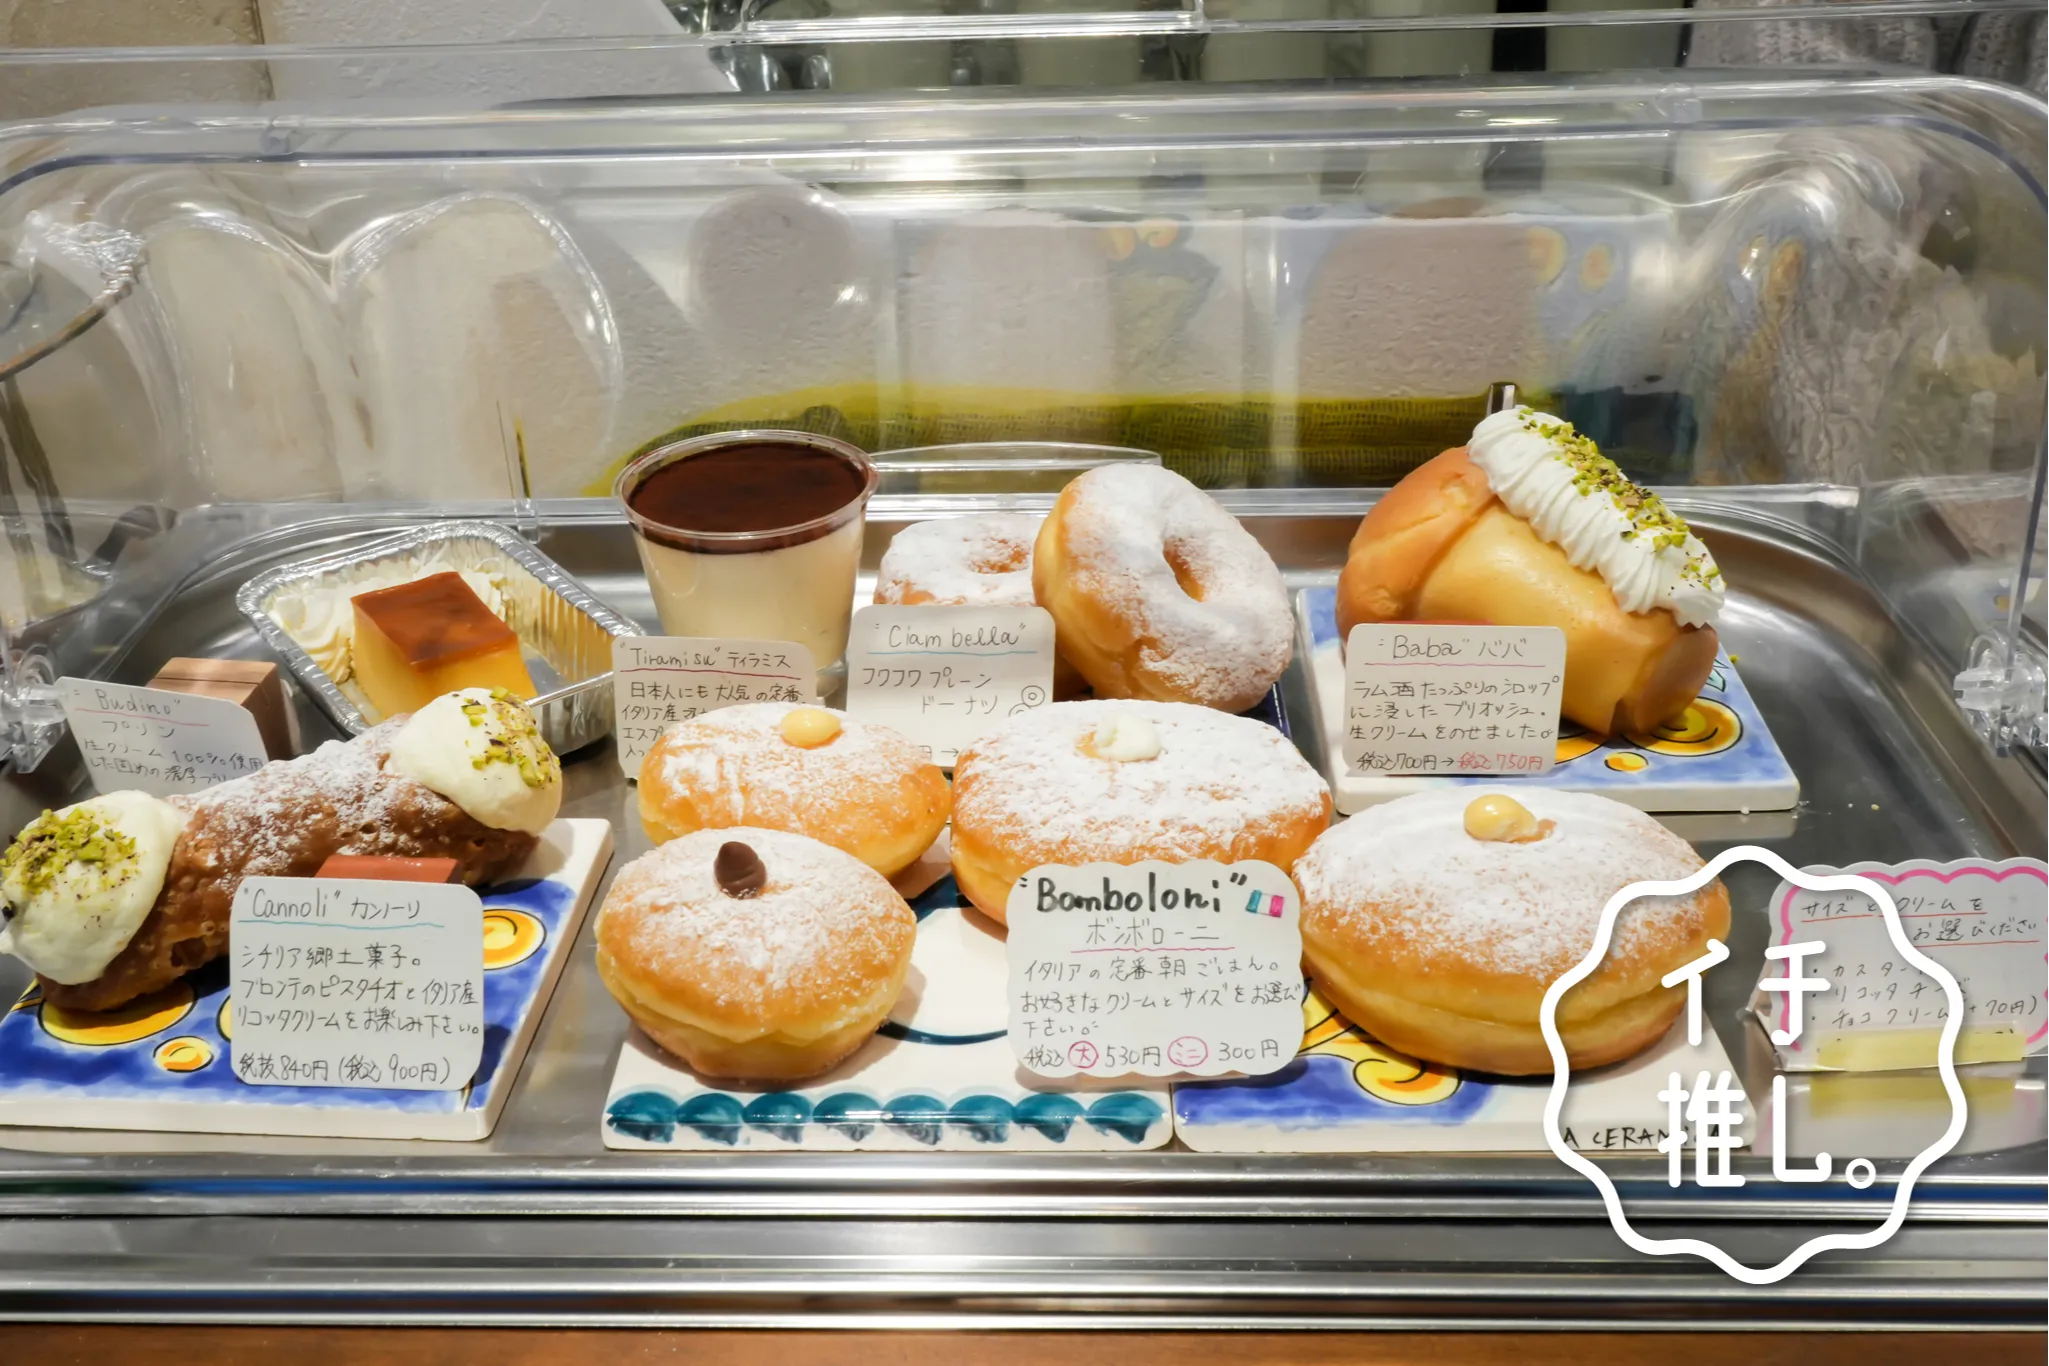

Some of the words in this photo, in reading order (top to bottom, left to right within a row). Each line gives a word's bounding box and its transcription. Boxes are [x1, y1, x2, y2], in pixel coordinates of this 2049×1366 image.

[728, 651, 791, 668] ティラミス
[922, 695, 998, 715] ドーナツ
[1086, 917, 1220, 946] ボンボローニ
